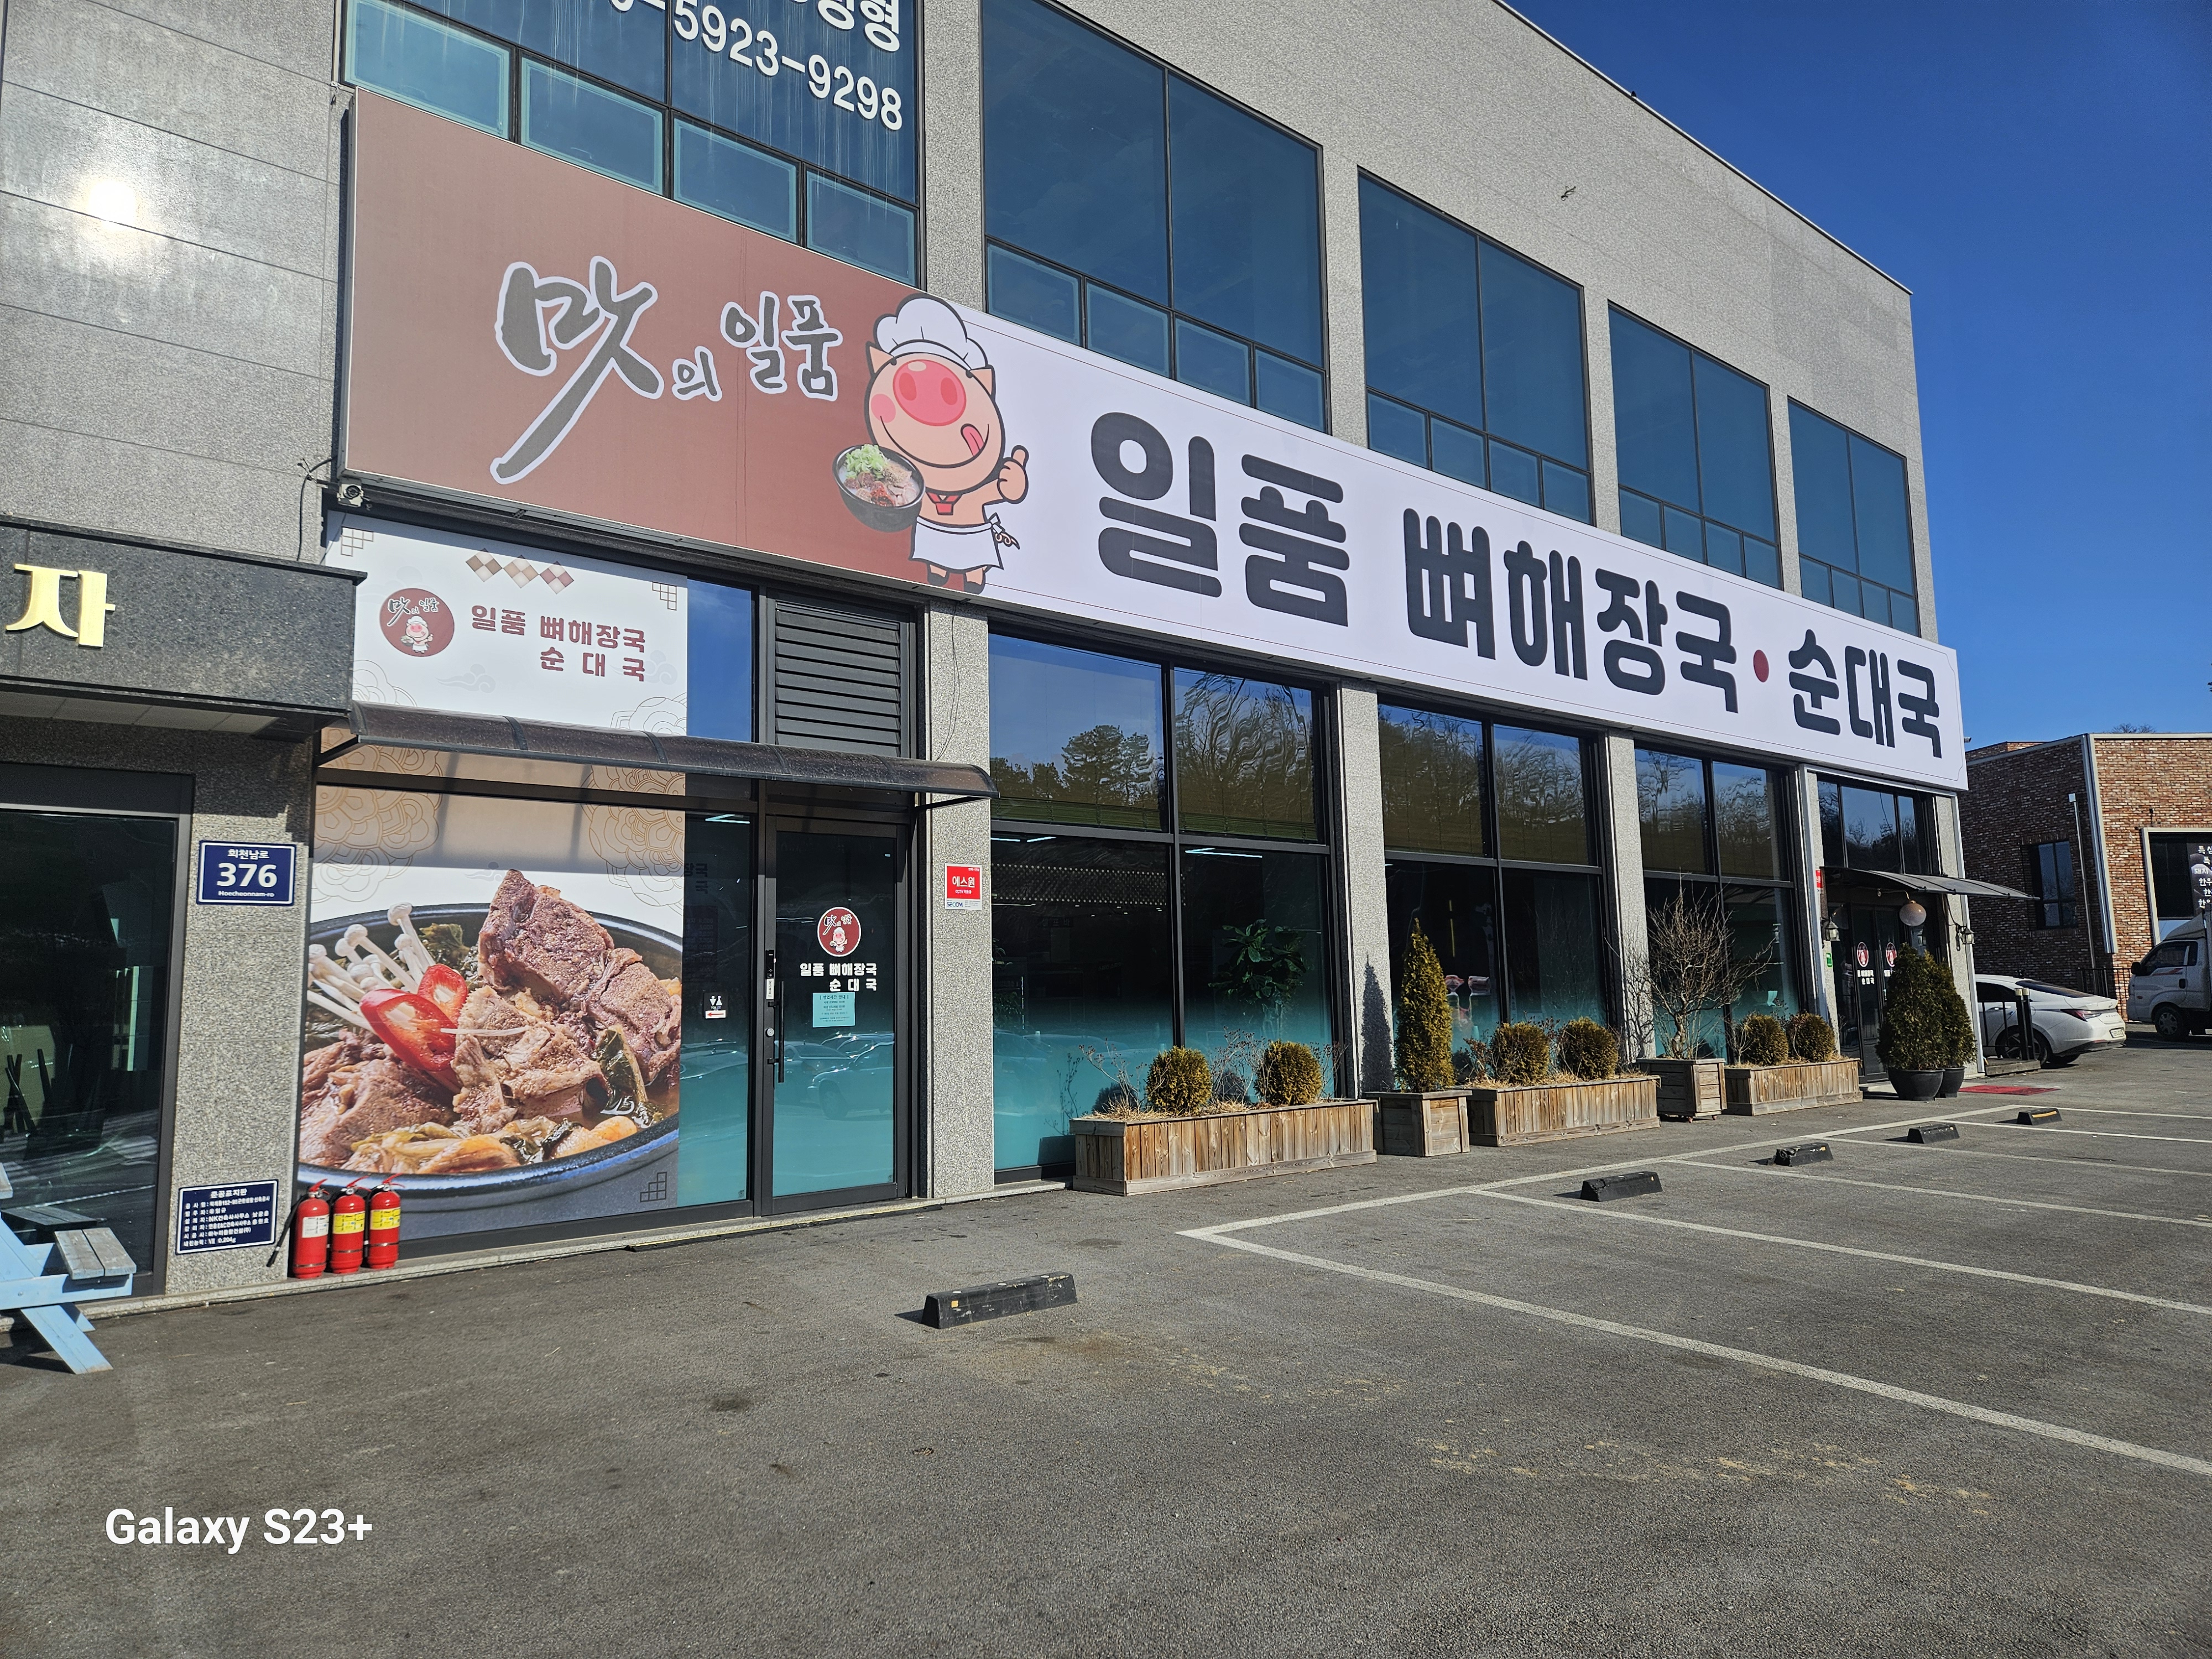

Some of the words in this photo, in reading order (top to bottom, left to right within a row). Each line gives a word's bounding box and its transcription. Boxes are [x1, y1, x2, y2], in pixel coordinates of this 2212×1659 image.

[612, 0, 902, 131] -5923-9298
[721, 291, 842, 401] 일품
[6, 564, 116, 648] 자
[1091, 411, 1350, 627] 일품
[1404, 508, 1739, 714] 뼈해장국
[1788, 629, 1942, 759] 순대국
[471, 605, 526, 636] 일품
[540, 615, 645, 653] 뼈해장국
[217, 863, 277, 888] 376
[227, 848, 270, 860] 회천남로
[952, 876, 975, 888] 에스원
[800, 963, 825, 977] 일품
[829, 963, 877, 976] 뼈해장국
